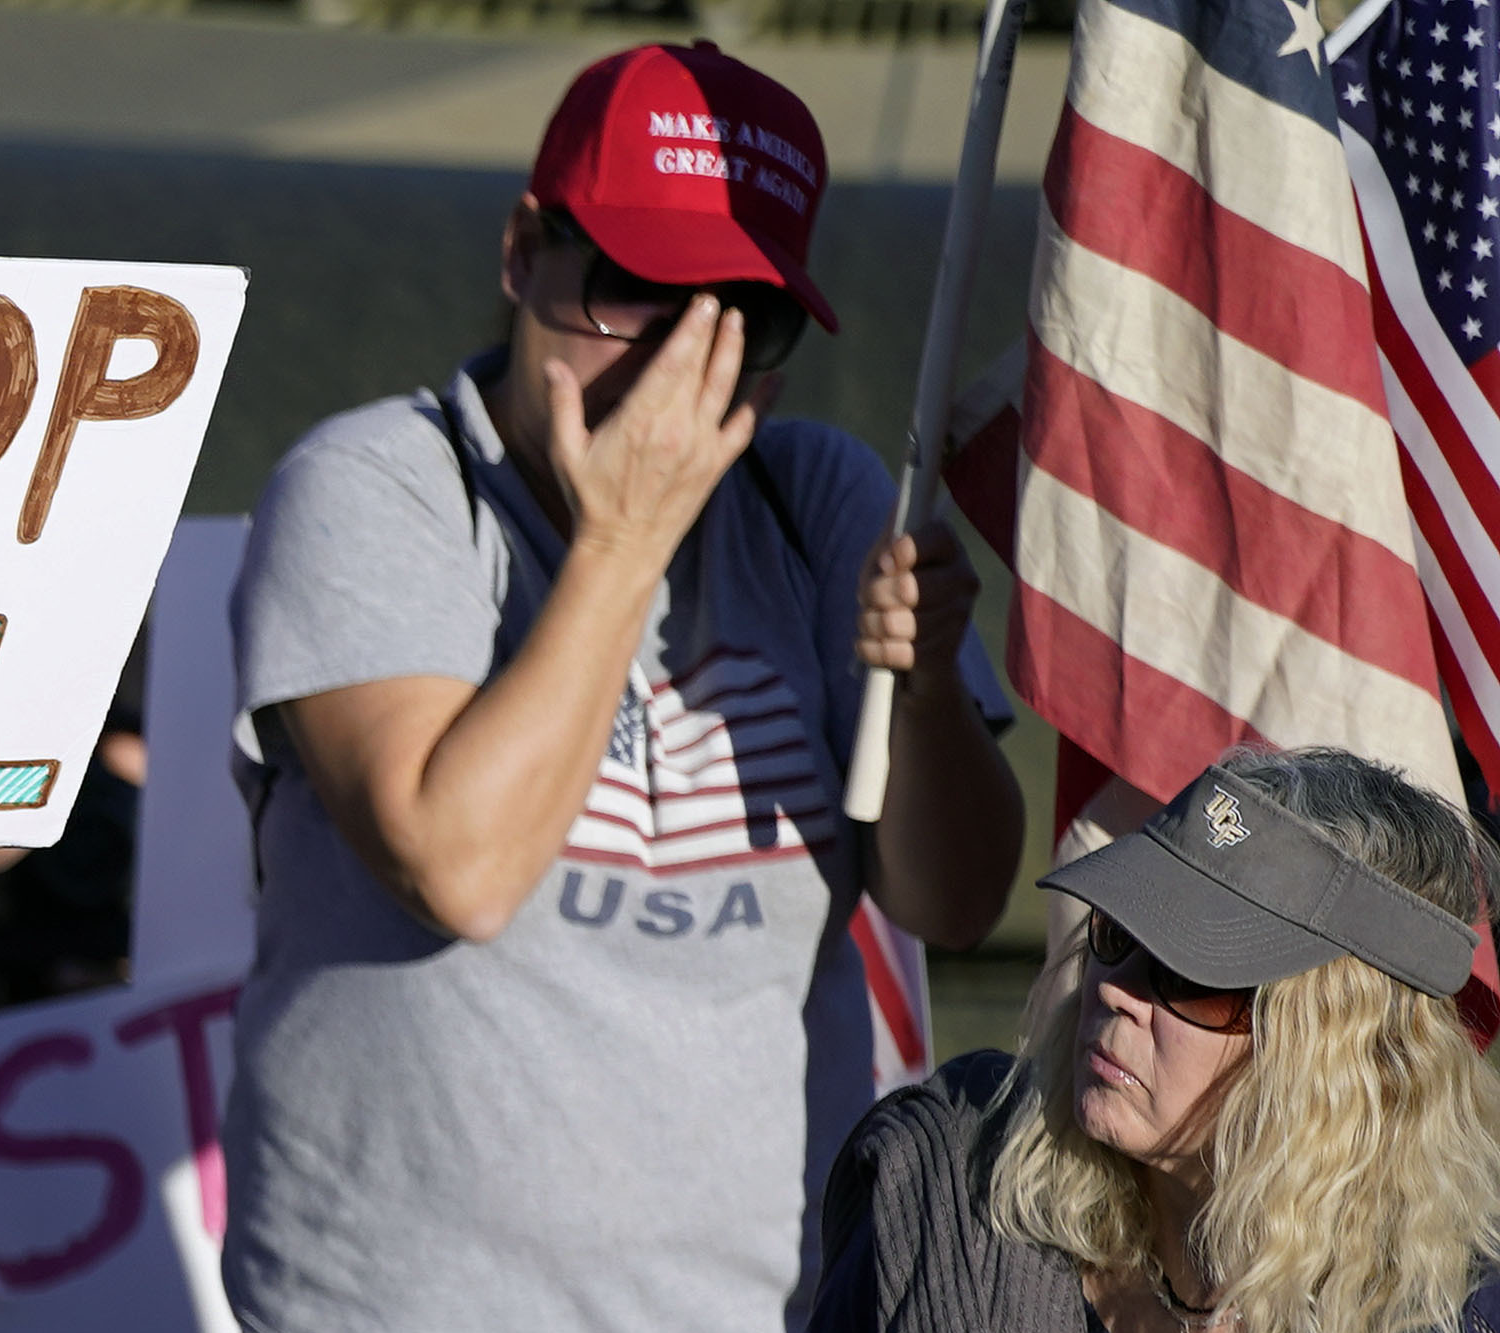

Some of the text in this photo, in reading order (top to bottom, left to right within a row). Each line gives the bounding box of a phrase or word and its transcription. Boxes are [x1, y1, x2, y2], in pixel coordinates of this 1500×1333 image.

[649, 111, 731, 143] MAKE
[654, 146, 751, 182] GREAT
[1203, 786, 1250, 847] UCF
[559, 871, 764, 938] USA
